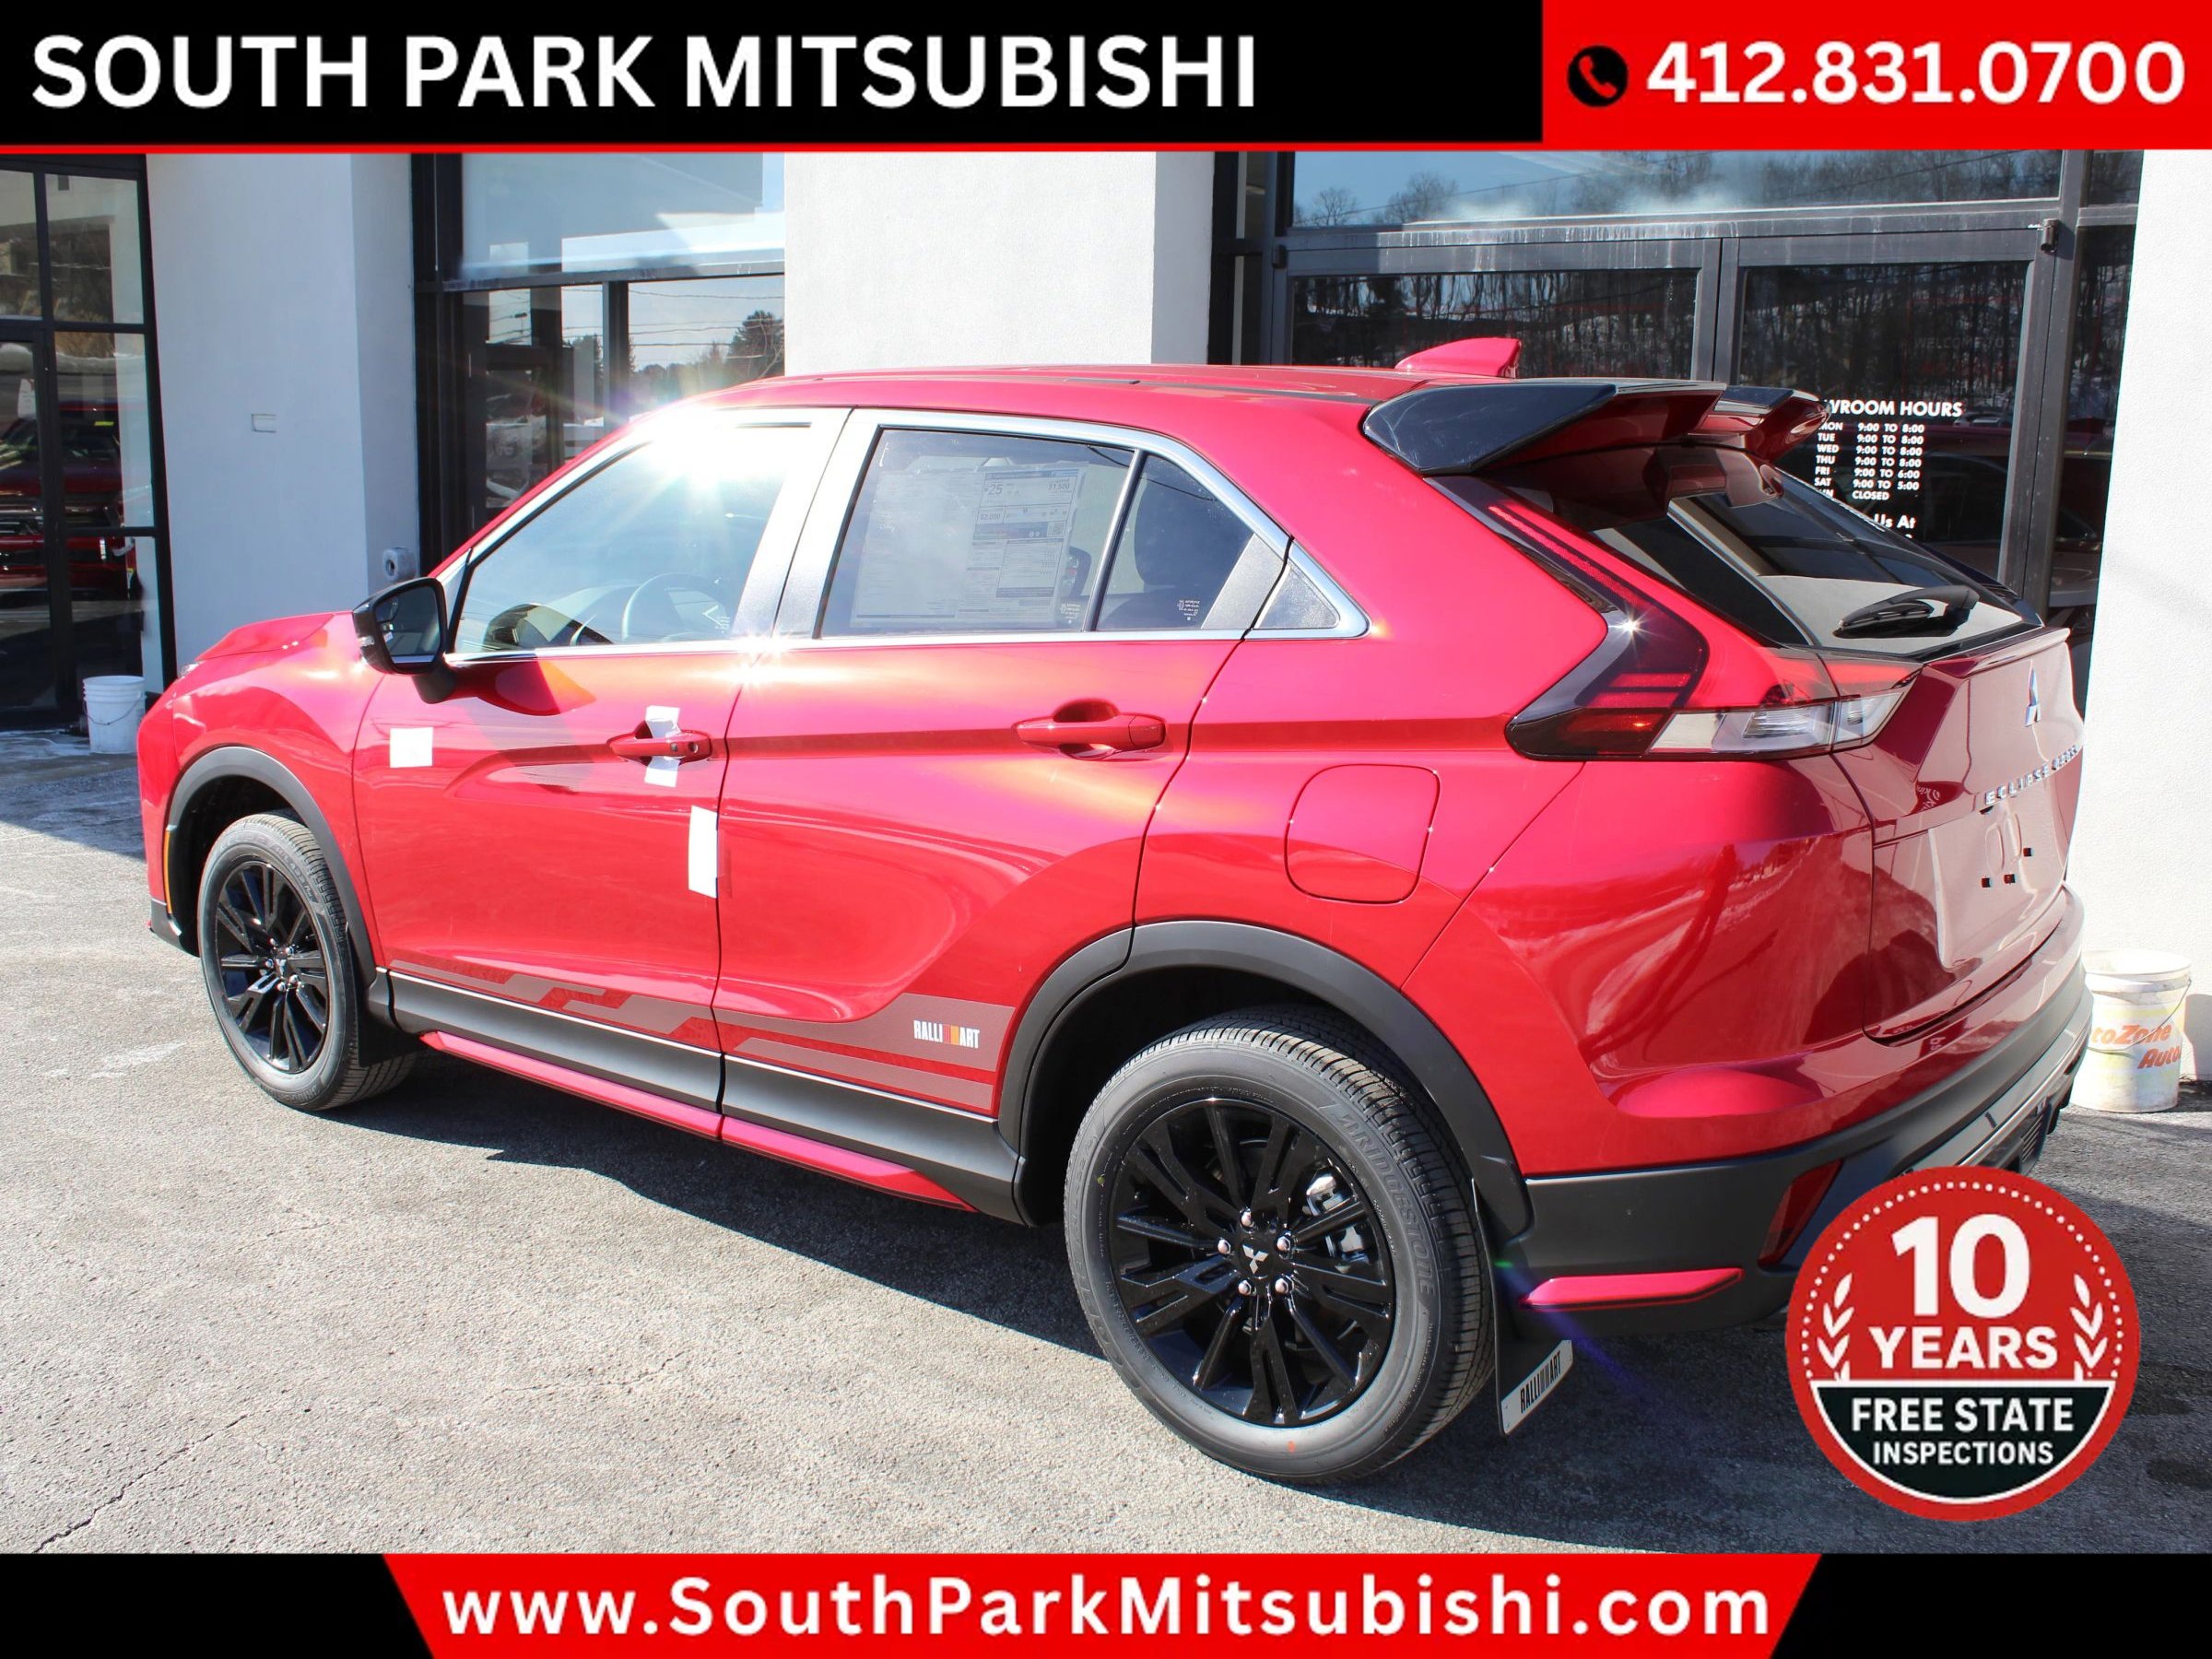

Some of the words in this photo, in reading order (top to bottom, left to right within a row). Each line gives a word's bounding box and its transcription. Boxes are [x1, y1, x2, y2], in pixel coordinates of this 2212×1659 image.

[1900, 401, 1963, 417] HOURS
[1857, 422, 1880, 432] 9:00
[1884, 423, 1899, 433] TO
[1901, 424, 1925, 434] 8:00
[1818, 432, 1836, 442] TUE
[1856, 434, 1878, 443] 9:00
[1882, 434, 1897, 444] TO
[1900, 435, 1924, 445] 8:00
[1817, 444, 1840, 453] WED
[1855, 445, 1878, 455] 9:00
[1881, 446, 1896, 456] TO
[1900, 447, 1924, 457] 8:00
[1816, 455, 1836, 465] THU
[1854, 456, 1877, 466] 9:00
[1881, 457, 1895, 467] TO
[1899, 458, 1923, 468] 8:00
[1815, 466, 1830, 476] FRI
[1853, 467, 1877, 477] 9:00
[1880, 468, 1894, 478] TO
[1897, 470, 1921, 479] 6:00
[1814, 477, 1832, 487] SAT
[1853, 479, 1875, 488] 9:00
[1877, 480, 1892, 489] TO
[1897, 481, 1920, 491] 5:00
[1852, 490, 1890, 501] CLOSED
[1897, 514, 1916, 530] At
[1984, 764, 2050, 806] ECLIPSE
[2090, 1023, 2172, 1045] toZone
